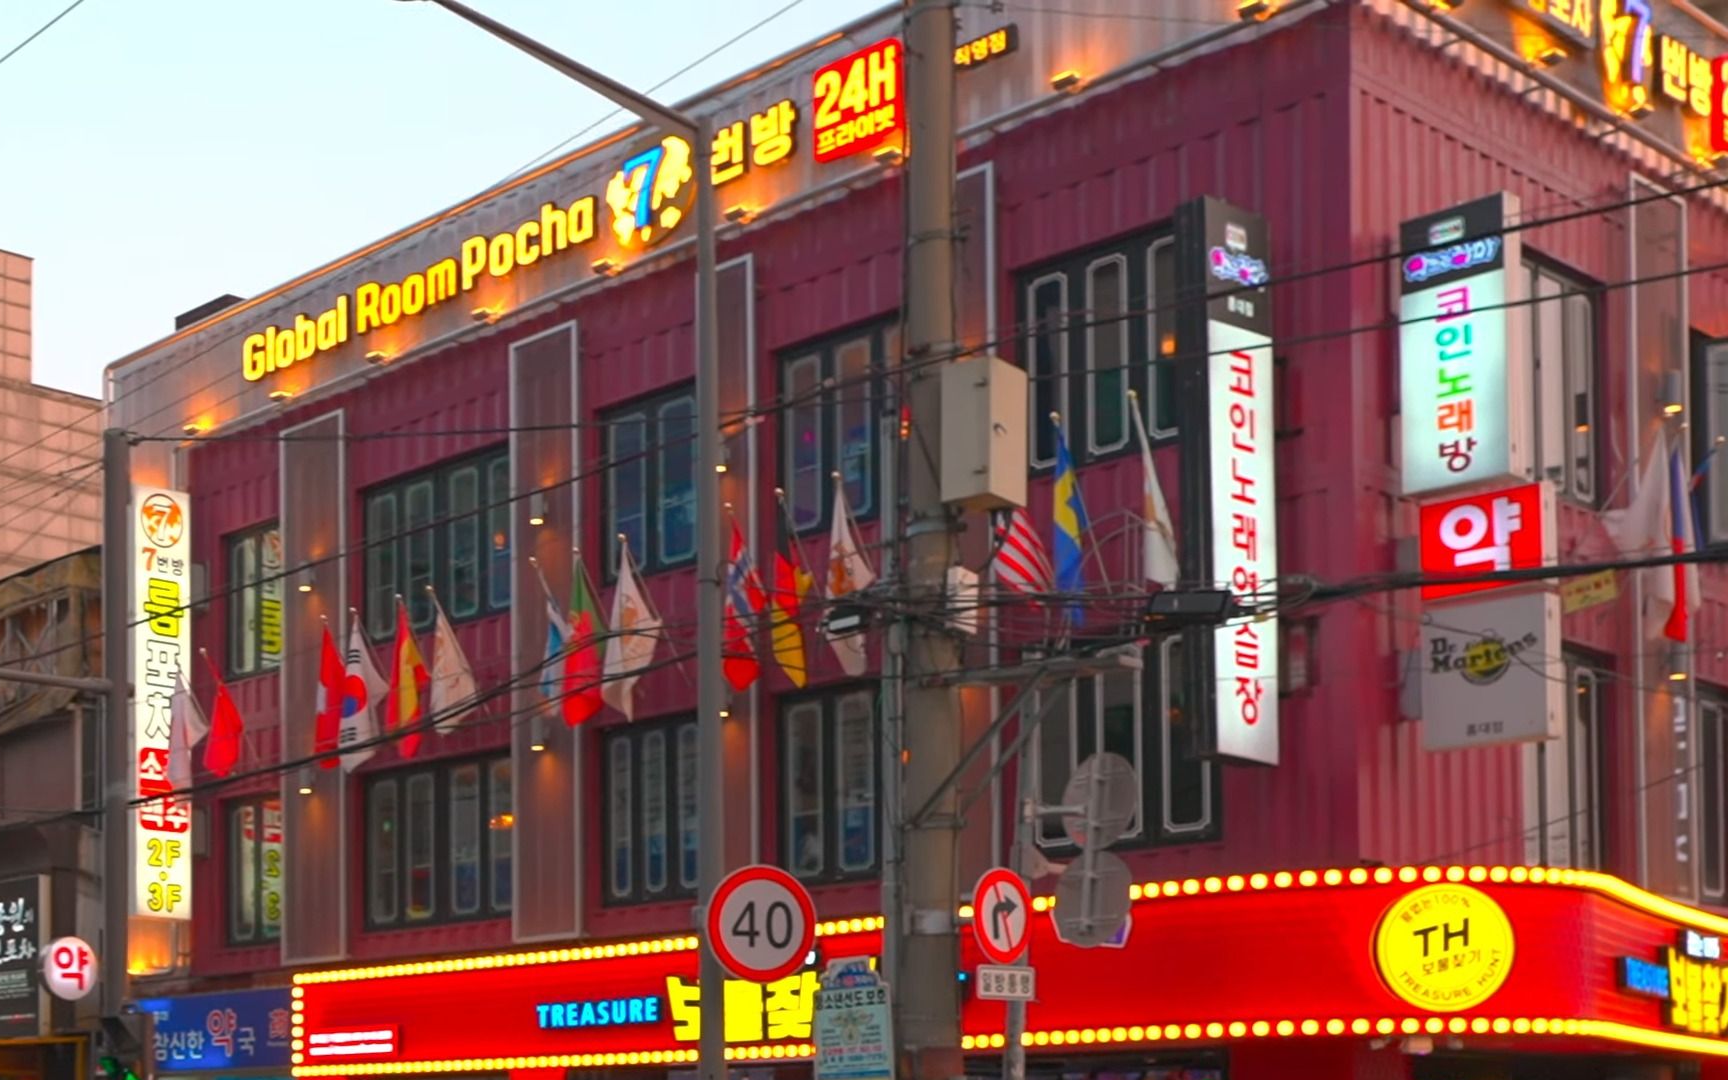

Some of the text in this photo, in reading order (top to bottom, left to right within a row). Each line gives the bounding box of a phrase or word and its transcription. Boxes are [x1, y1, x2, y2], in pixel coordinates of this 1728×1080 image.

[814, 44, 896, 130] 24H
[1661, 34, 1713, 118] 번방
[710, 99, 796, 187] 번방
[242, 194, 595, 382] Global Room Pocha
[1435, 286, 1476, 473] 코인노래방
[1438, 496, 1523, 572] 약
[146, 837, 181, 869] 2F
[146, 881, 182, 913] 3F
[731, 900, 794, 950] 40
[1412, 917, 1470, 957] TH
[53, 946, 90, 991] 약
[1399, 948, 1501, 1001] TREASURE HUNT
[1421, 949, 1482, 977] 보물찾기
[536, 996, 659, 1029] TREASURE
